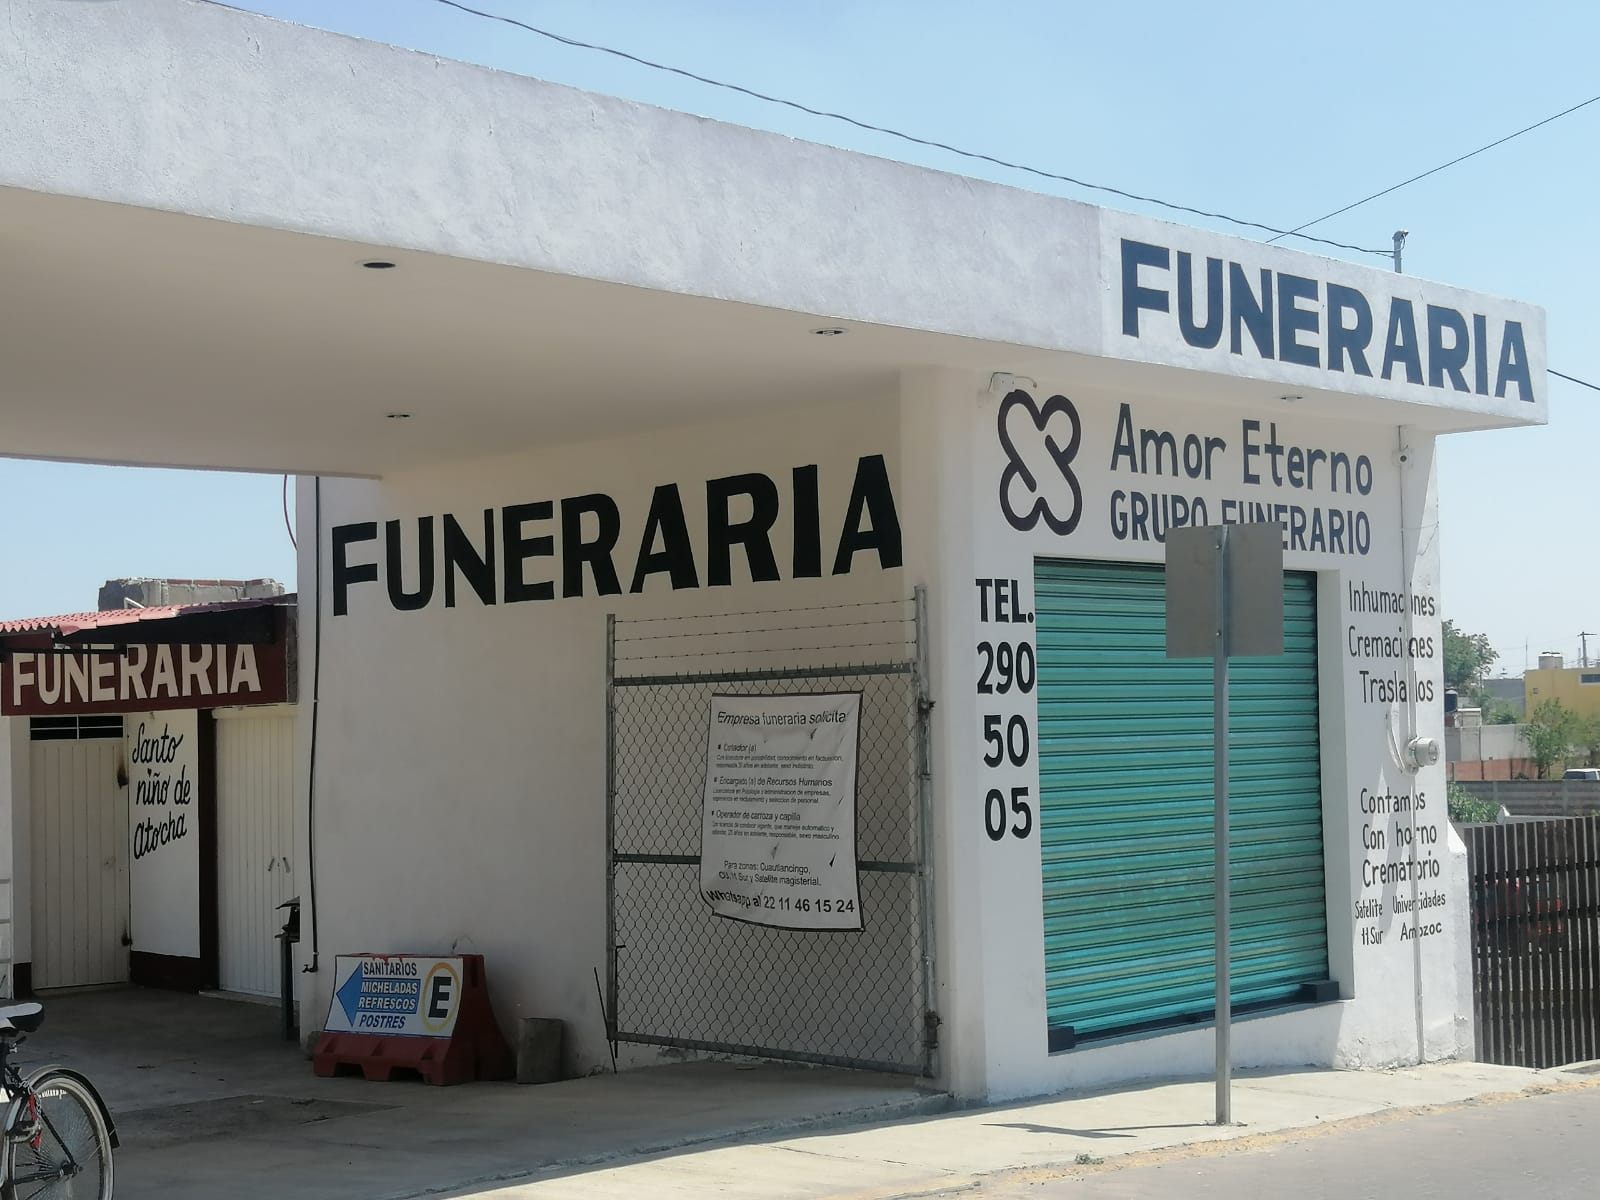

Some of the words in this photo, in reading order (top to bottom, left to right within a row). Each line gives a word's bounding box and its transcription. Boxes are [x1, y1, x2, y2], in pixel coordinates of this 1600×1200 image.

[1121, 238, 1535, 403] FUNERARIA
[1110, 403, 1227, 481] Amor
[1242, 419, 1373, 496] Eterno
[331, 454, 904, 616] FUNERARIA
[975, 578, 1035, 624] TEL.
[1348, 580, 1436, 617] Inhumacnes
[12, 643, 262, 706] FUNERARIA
[976, 641, 1036, 695] 290
[1359, 670, 1434, 704] Traslaos
[717, 711, 760, 726] Empresa
[762, 711, 806, 726] funeraria
[132, 722, 184, 765] Santo
[983, 714, 1030, 768] 50
[136, 768, 170, 806] niño
[174, 764, 192, 806] de
[766, 776, 797, 787] Recursos
[798, 777, 833, 787] Humanos
[984, 786, 1032, 841] 05
[1362, 823, 1385, 851] Con
[753, 895, 762, 908] al
[764, 896, 776, 909] 22
[779, 897, 790, 911] 11
[795, 898, 810, 913] 46
[815, 898, 832, 913] 15
[836, 899, 855, 913] 24
[1354, 898, 1383, 920] Satelite
[1391, 889, 1447, 916] Univeridades
[360, 981, 418, 995] MICHELADAS
[363, 962, 418, 977] SANITARIOS
[358, 997, 416, 1010] REFRESCOS
[428, 976, 452, 1018] E
[359, 1014, 406, 1029] POSTRES
